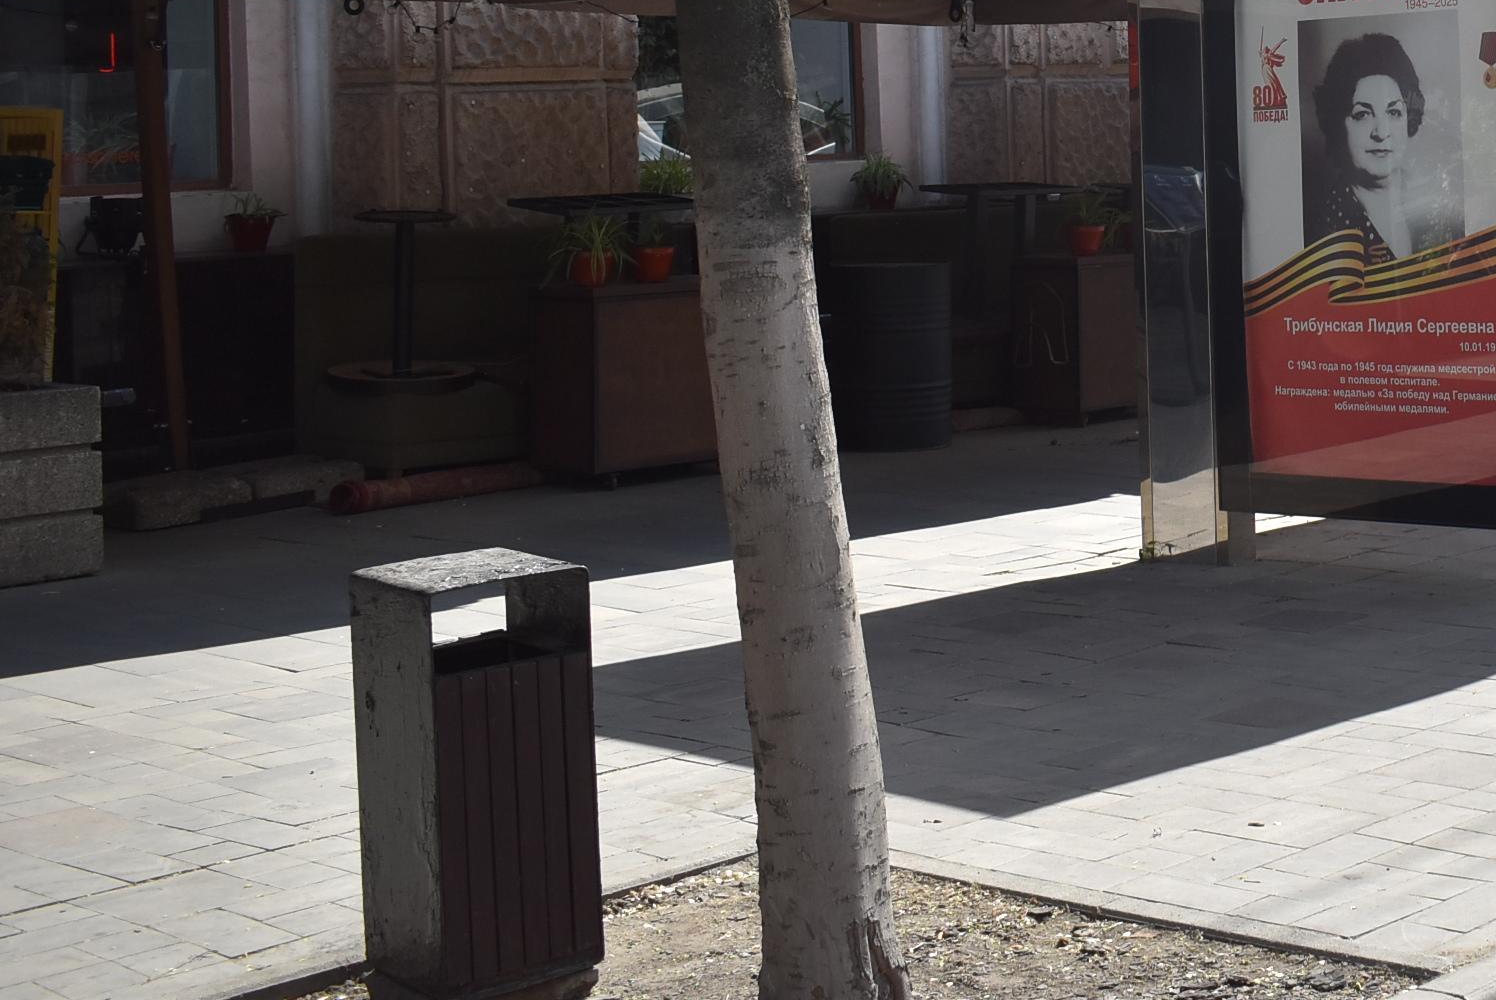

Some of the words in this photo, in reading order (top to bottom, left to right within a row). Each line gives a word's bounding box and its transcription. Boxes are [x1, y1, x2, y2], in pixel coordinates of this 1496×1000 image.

[1253, 86, 1271, 106] 80
[1253, 110, 1288, 123] ПОБЕДА!
[1284, 317, 1363, 335] Трибунская
[1368, 318, 1413, 335] Лидия
[1417, 318, 1495, 336] Сергеевна
[1287, 360, 1294, 370] С
[1296, 360, 1317, 370] 1943
[1318, 362, 1338, 372] года
[1340, 362, 1352, 371] по
[1355, 361, 1375, 371] 1945
[1377, 364, 1393, 373] год
[1394, 364, 1436, 375] служила
[1438, 364, 1496, 376] медсестрой
[1347, 377, 1388, 385] полевом
[1390, 377, 1441, 386] госпитале.
[1275, 386, 1331, 397] Награждена:
[1333, 389, 1375, 398] медалью
[1378, 388, 1394, 398] «За
[1396, 389, 1430, 401] победу
[1433, 391, 1451, 401] над
[1334, 401, 1397, 412] юбилейными
[1398, 404, 1450, 414] медалями.
